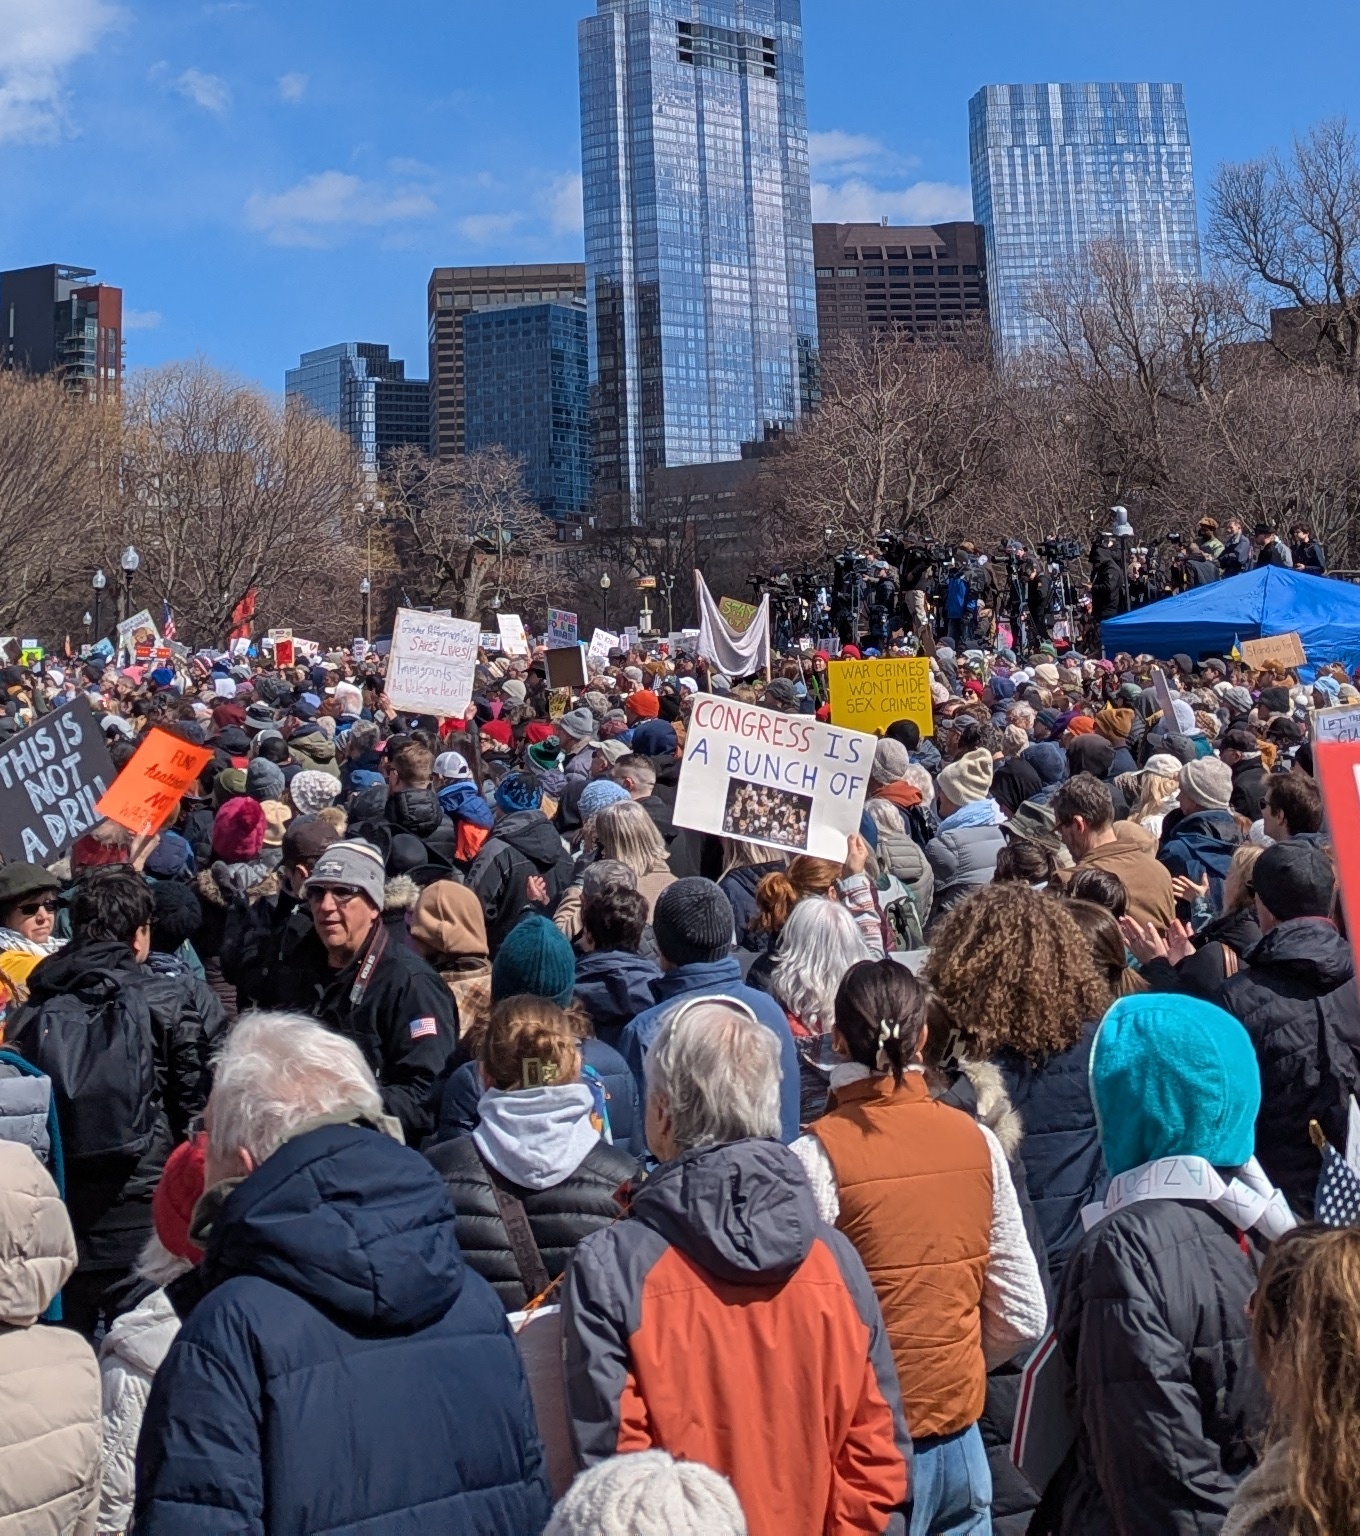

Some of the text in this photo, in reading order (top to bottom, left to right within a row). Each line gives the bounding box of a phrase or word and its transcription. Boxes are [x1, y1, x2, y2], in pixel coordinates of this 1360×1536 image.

[722, 601, 757, 619] STAY
[396, 658, 452, 681] Immigrants
[841, 661, 925, 680] WAR CRIMES
[405, 679, 439, 695] Welcome
[895, 677, 926, 694] HIDE
[846, 696, 927, 714] SEX CRIMES
[54, 711, 83, 754] IS
[695, 700, 863, 764] CONGRESS IS
[1322, 717, 1346, 731] LET
[687, 738, 864, 800] A BUNCH OF
[23, 751, 82, 814] NOT
[20, 827, 49, 864] A
